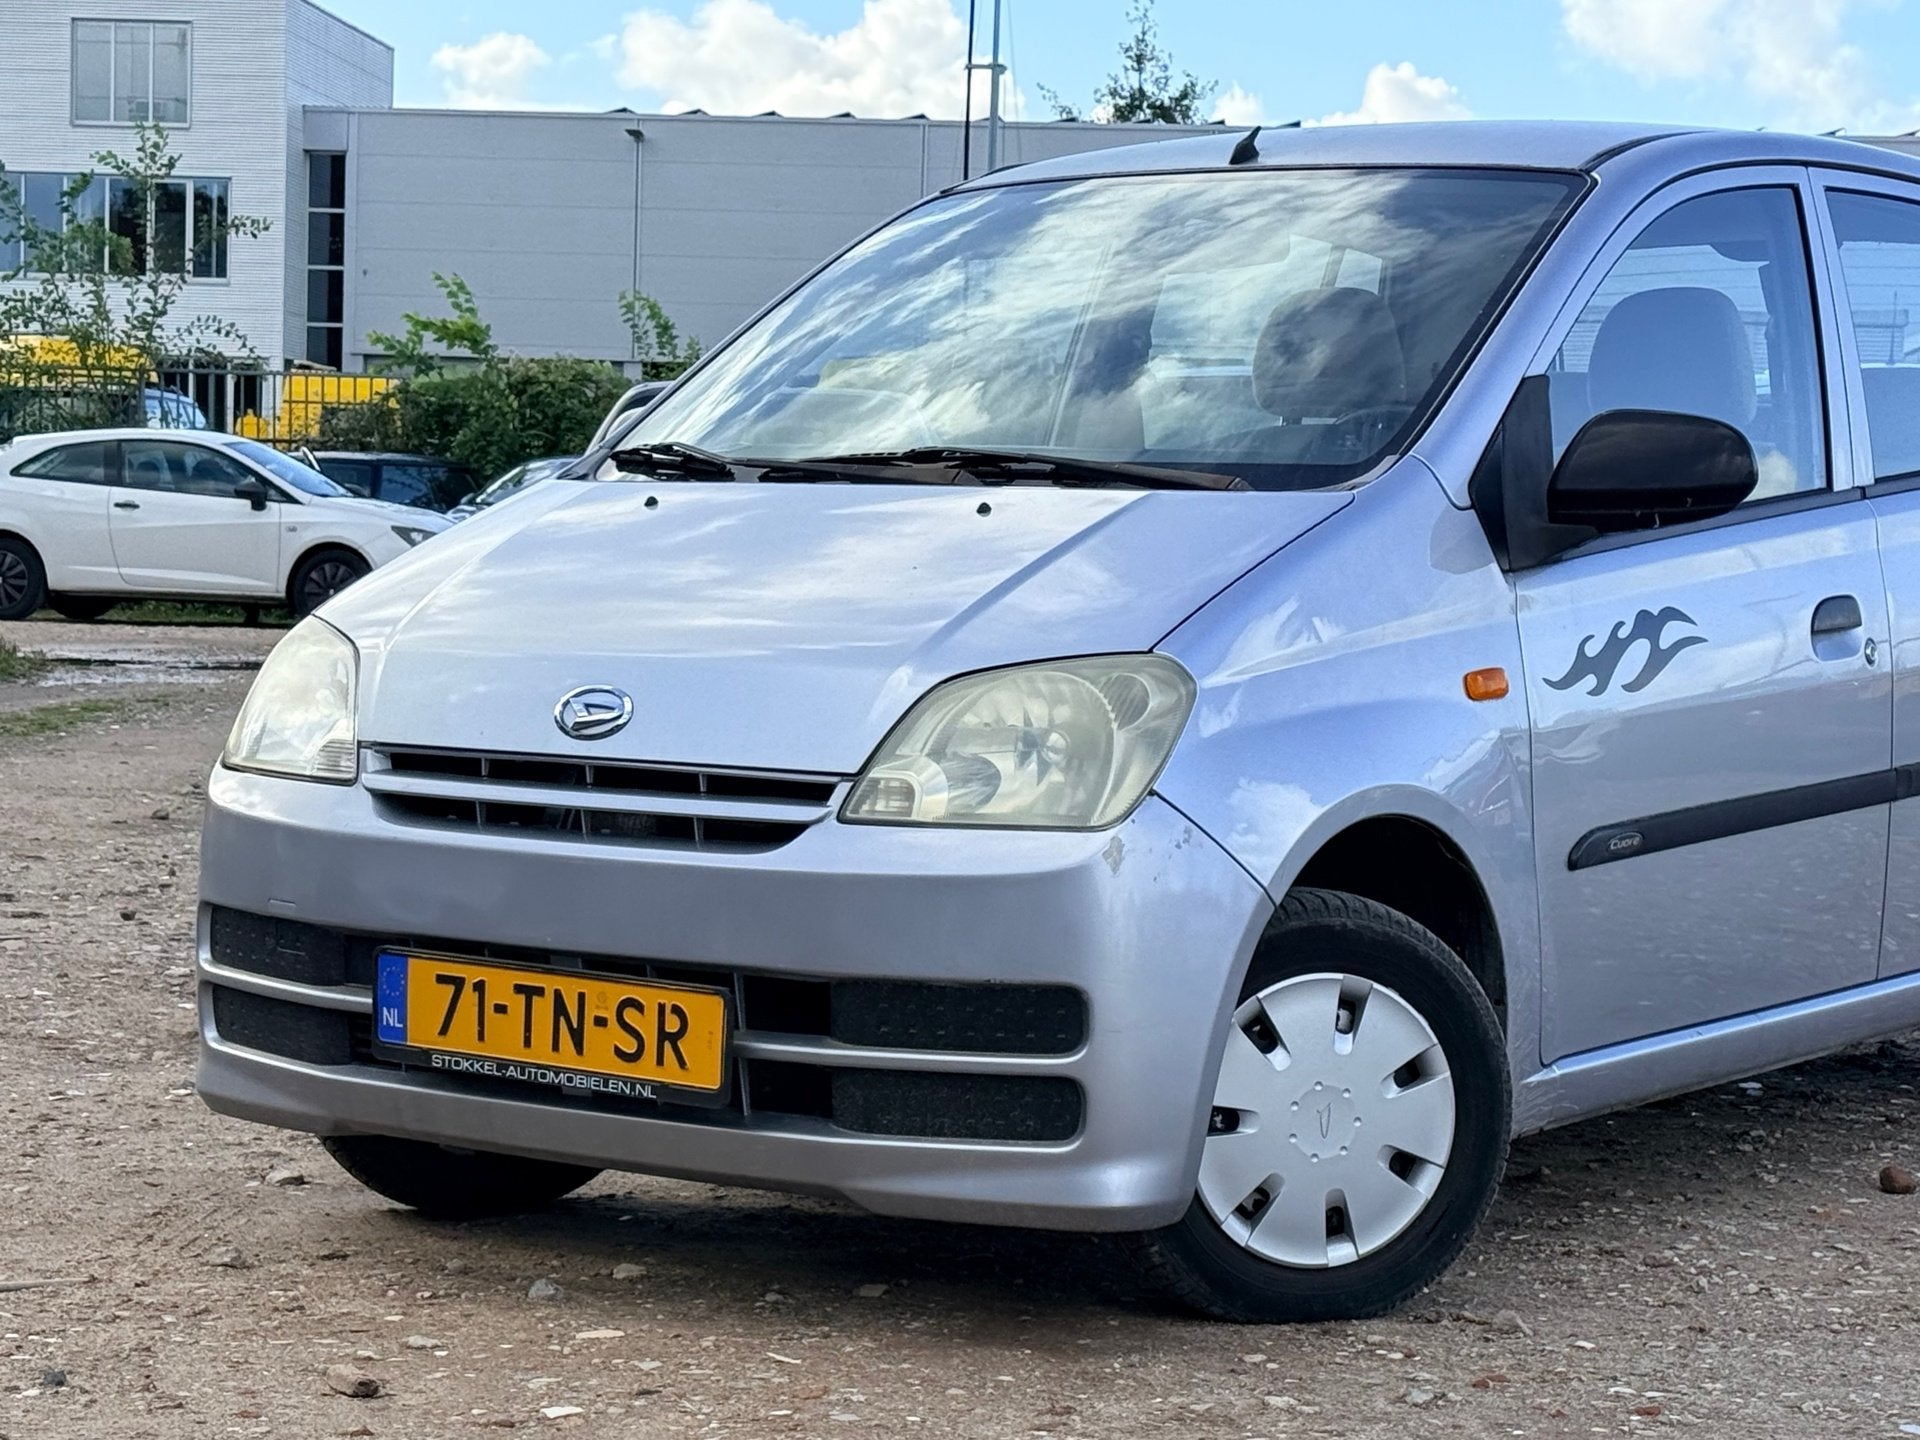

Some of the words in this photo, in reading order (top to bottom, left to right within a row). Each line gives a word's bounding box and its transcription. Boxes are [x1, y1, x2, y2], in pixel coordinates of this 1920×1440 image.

[1610, 837, 1640, 850] Cuore
[382, 1006, 404, 1029] NL
[434, 973, 690, 1070] 71-TN-SR
[432, 1054, 657, 1099] STOKKEL-AUTOMOBIELEN.NL
